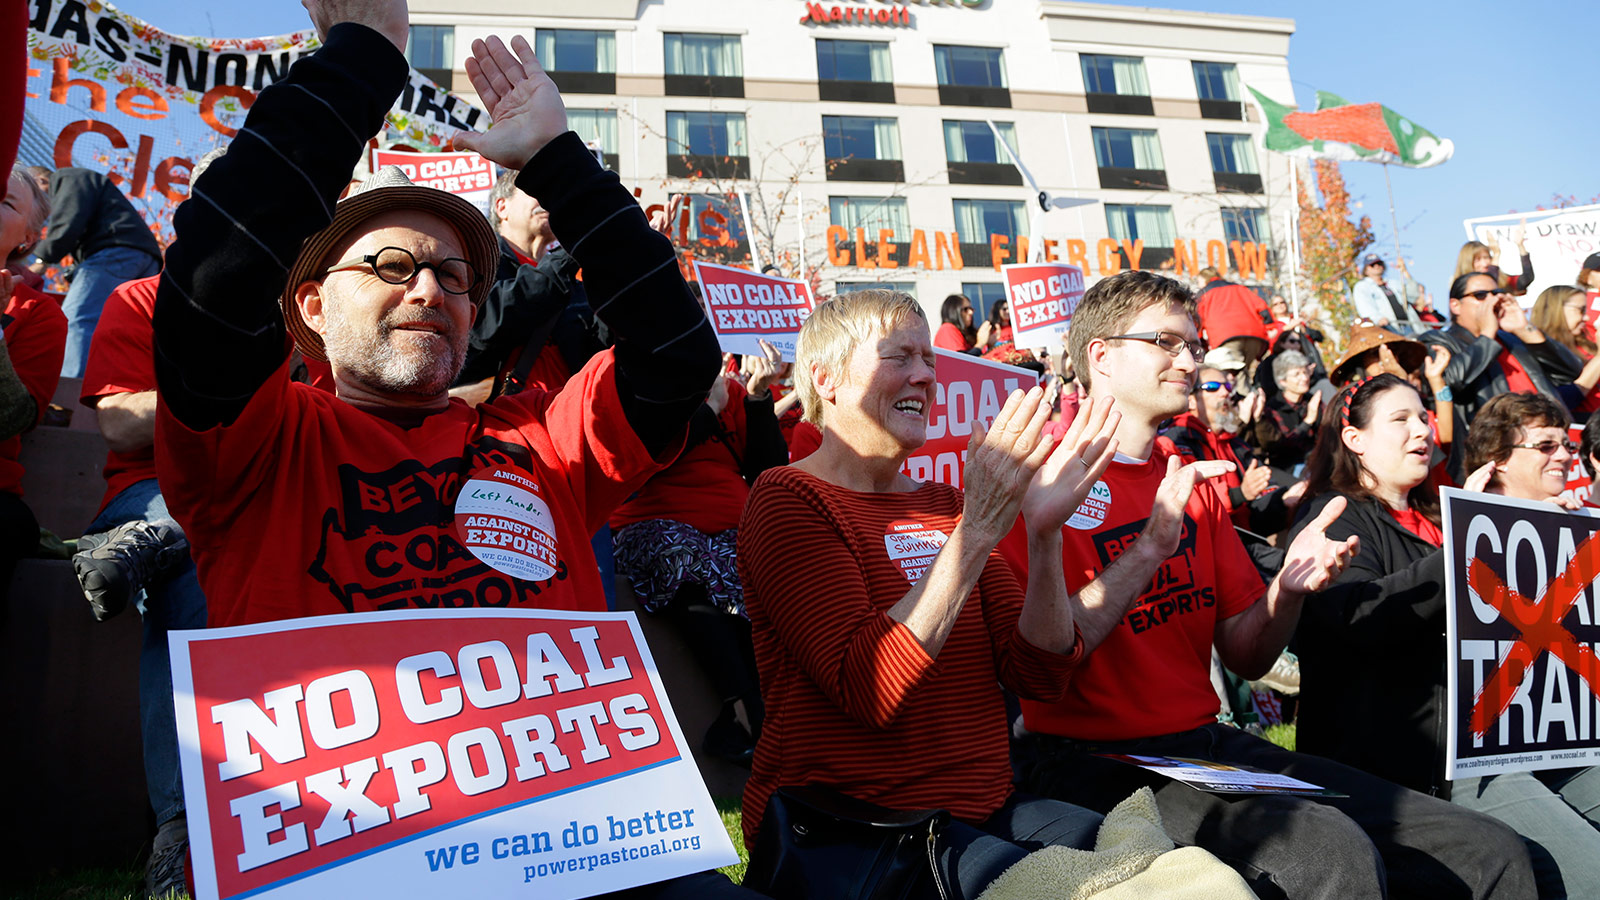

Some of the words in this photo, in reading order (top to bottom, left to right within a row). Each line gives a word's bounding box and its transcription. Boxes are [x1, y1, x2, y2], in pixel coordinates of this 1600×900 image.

[800, 1, 910, 25] Marriott
[420, 157, 487, 179] COAL
[826, 224, 964, 271] CLEAN
[1174, 238, 1267, 281] NOW
[706, 284, 743, 305] NO
[744, 284, 805, 305] COAL
[1011, 279, 1046, 306] NO
[1047, 272, 1085, 297] COAL
[715, 308, 811, 329] EXPORTS
[1017, 295, 1083, 328] EXPOR
[493, 470, 539, 492] ANOTHER
[471, 488, 501, 501] Left
[505, 496, 543, 517] hander
[1085, 499, 1107, 510] COAL
[464, 516, 531, 536] AGAINST
[531, 530, 557, 552] COAL
[466, 529, 557, 567] EXPORTS
[365, 533, 477, 578] COA
[497, 554, 514, 563] CAN
[515, 557, 526, 566] DO
[525, 559, 550, 576] BETTER
[212, 669, 382, 783] NO
[396, 625, 633, 725] COAL
[230, 693, 662, 874] EXPORTS
[425, 843, 480, 873] we
[492, 828, 554, 861] can
[561, 820, 600, 850] do
[607, 804, 696, 844] better
[523, 833, 702, 883] powerpastcoal.org
